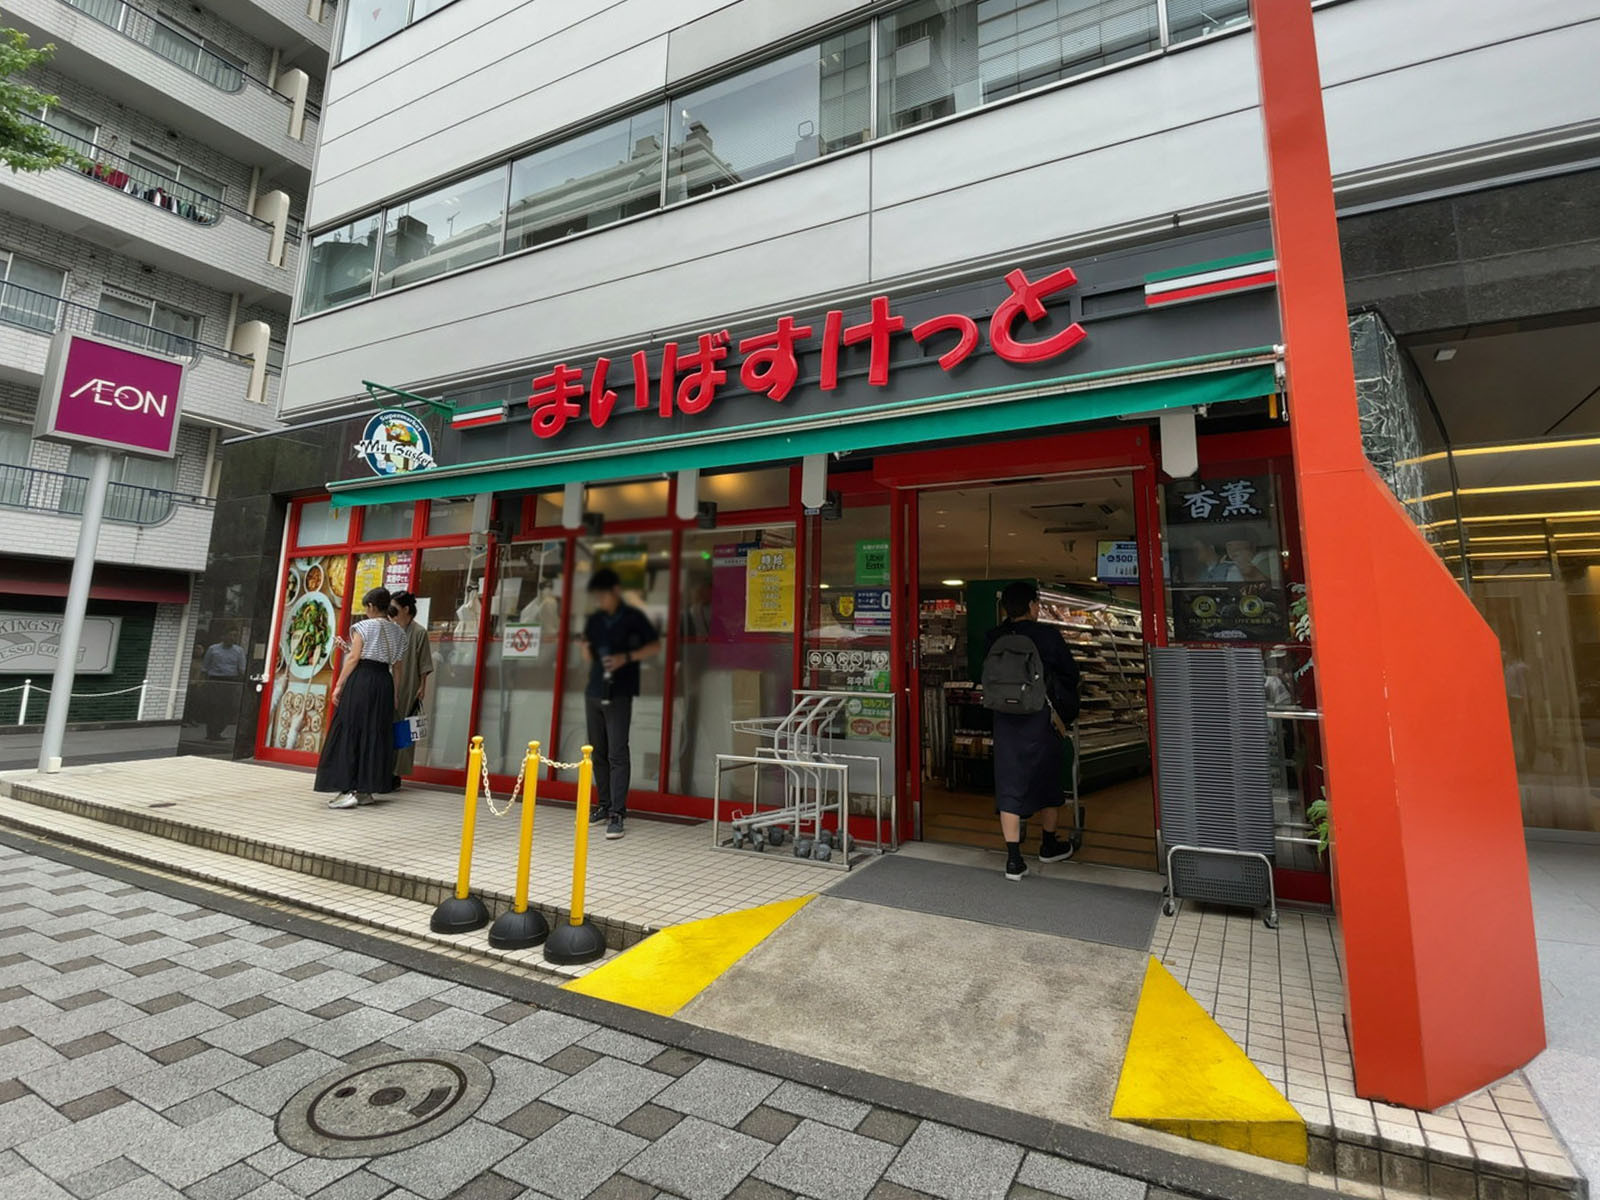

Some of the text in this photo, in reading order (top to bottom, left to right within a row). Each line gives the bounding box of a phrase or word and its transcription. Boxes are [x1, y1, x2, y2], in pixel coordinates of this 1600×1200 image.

[527, 268, 1088, 439] まいばすけっと
[360, 440, 388, 455] My
[1183, 480, 1258, 519] 香薫
[0, 619, 64, 634] KINGST
